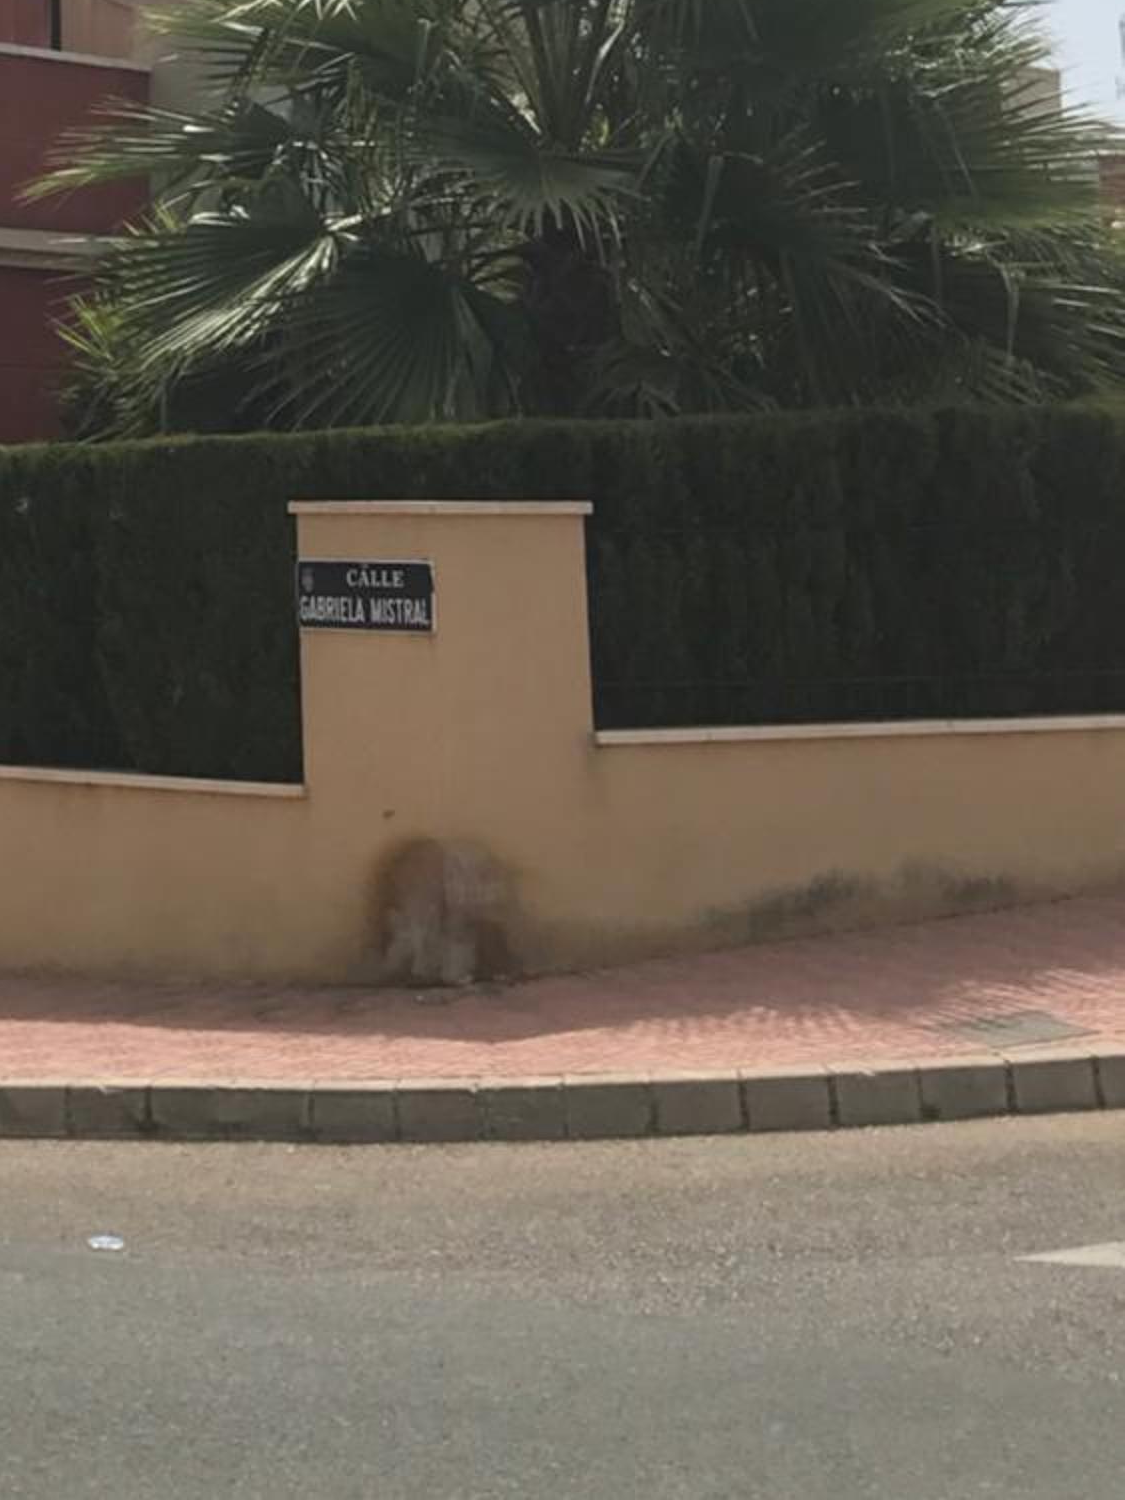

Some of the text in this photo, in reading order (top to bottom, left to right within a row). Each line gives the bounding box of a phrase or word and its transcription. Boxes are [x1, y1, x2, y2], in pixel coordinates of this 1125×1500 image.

[346, 568, 405, 588] CALLE
[300, 595, 430, 625] GABRIELA MISTRAL
